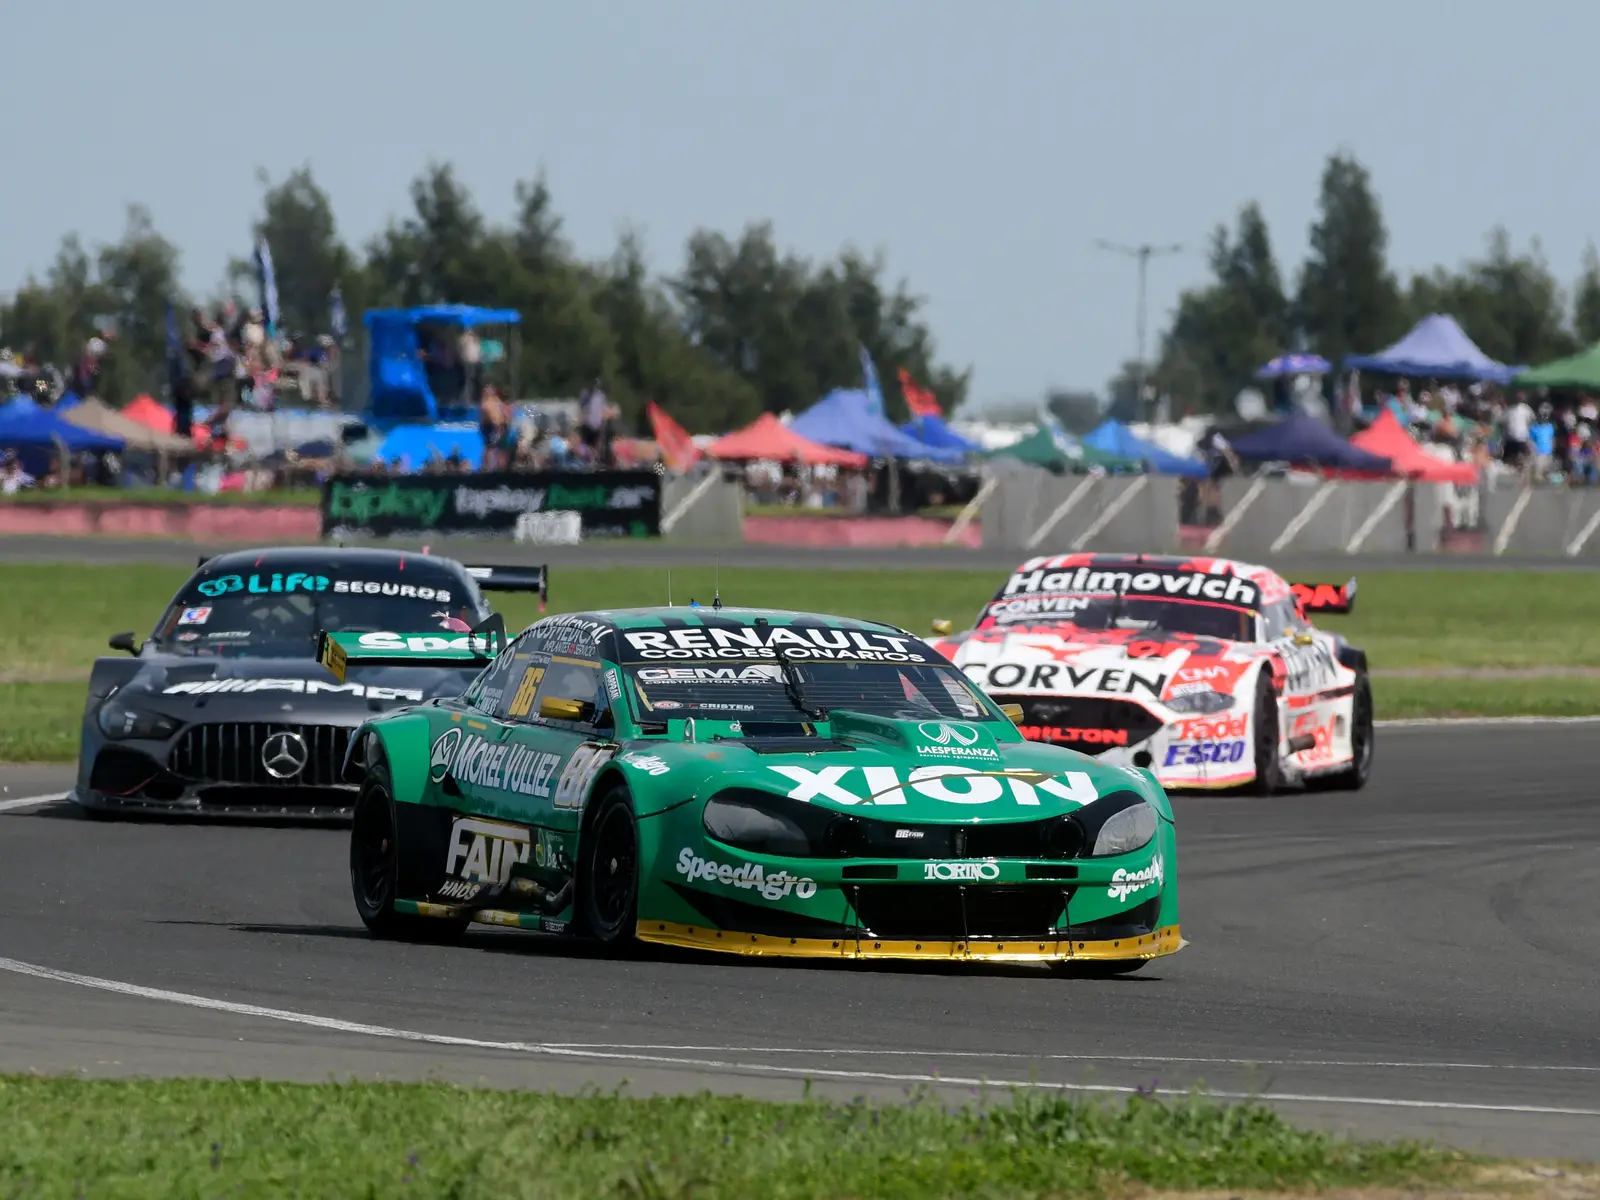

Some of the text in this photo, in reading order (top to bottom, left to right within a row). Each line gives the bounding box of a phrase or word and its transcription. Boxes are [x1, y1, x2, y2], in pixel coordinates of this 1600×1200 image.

[333, 580, 451, 602] SEGUROS
[1004, 567, 1256, 605] Haimovich
[988, 597, 1090, 616] CORVEN
[624, 627, 909, 653] RENAULT
[640, 647, 926, 663] CONCESONARIOS
[637, 668, 774, 680] CEMA
[509, 667, 546, 716] 86
[452, 735, 561, 798] MOREL VULLIEZ
[1163, 740, 1245, 767] ESCO
[766, 765, 1098, 806] XION
[446, 817, 530, 884] FAIN
[676, 847, 817, 901] SpeedAgro
[924, 863, 1000, 882] TORINO
[437, 880, 481, 900] HNOS
